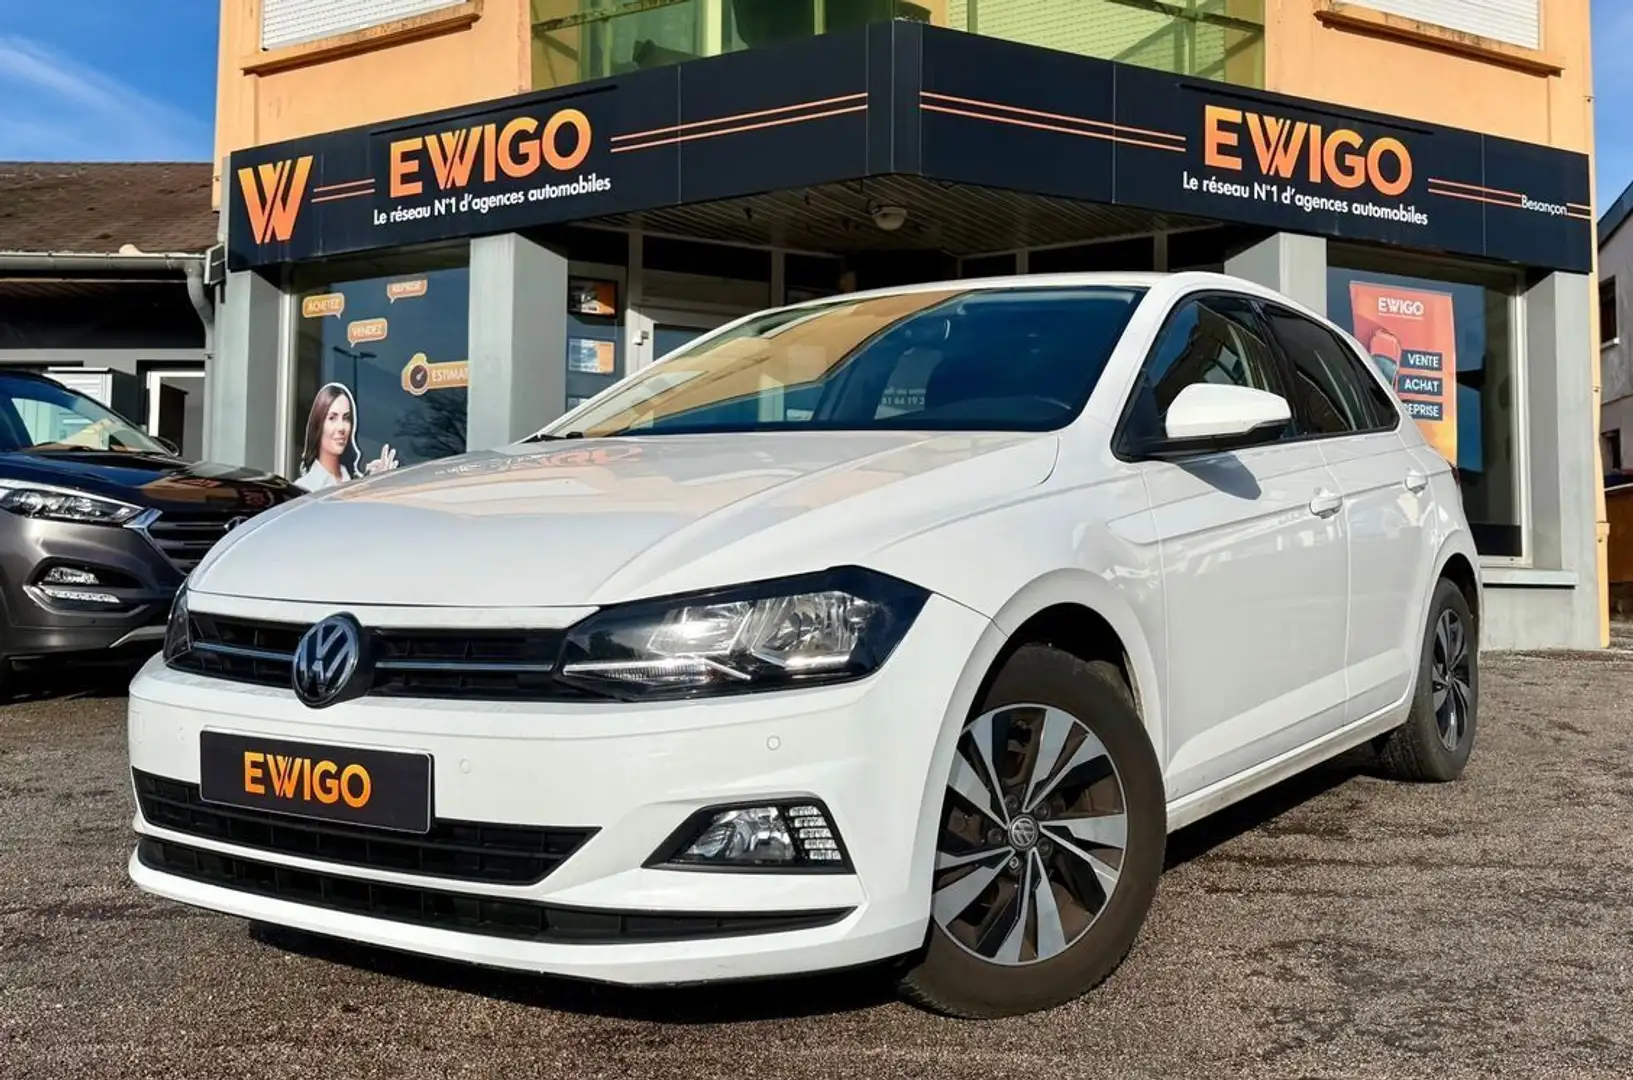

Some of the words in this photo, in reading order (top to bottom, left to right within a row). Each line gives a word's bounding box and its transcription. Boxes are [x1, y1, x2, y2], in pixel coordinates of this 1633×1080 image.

[389, 108, 592, 198] EWIGO
[1204, 104, 1413, 196] EWIGO
[373, 208, 387, 226] Le
[390, 205, 431, 223] réseau
[459, 190, 525, 214] d'agences
[528, 174, 611, 201] automobiles
[1183, 171, 1198, 190] Le
[1202, 176, 1250, 198] réseau
[1281, 188, 1349, 213] d'agences
[1352, 201, 1429, 226] automobiles
[1521, 194, 1568, 216] Besançon
[1378, 297, 1424, 315] EWIGO
[1404, 379, 1439, 392] ACHAT
[1407, 353, 1439, 368] VENTE
[244, 752, 372, 808] EWIGO
